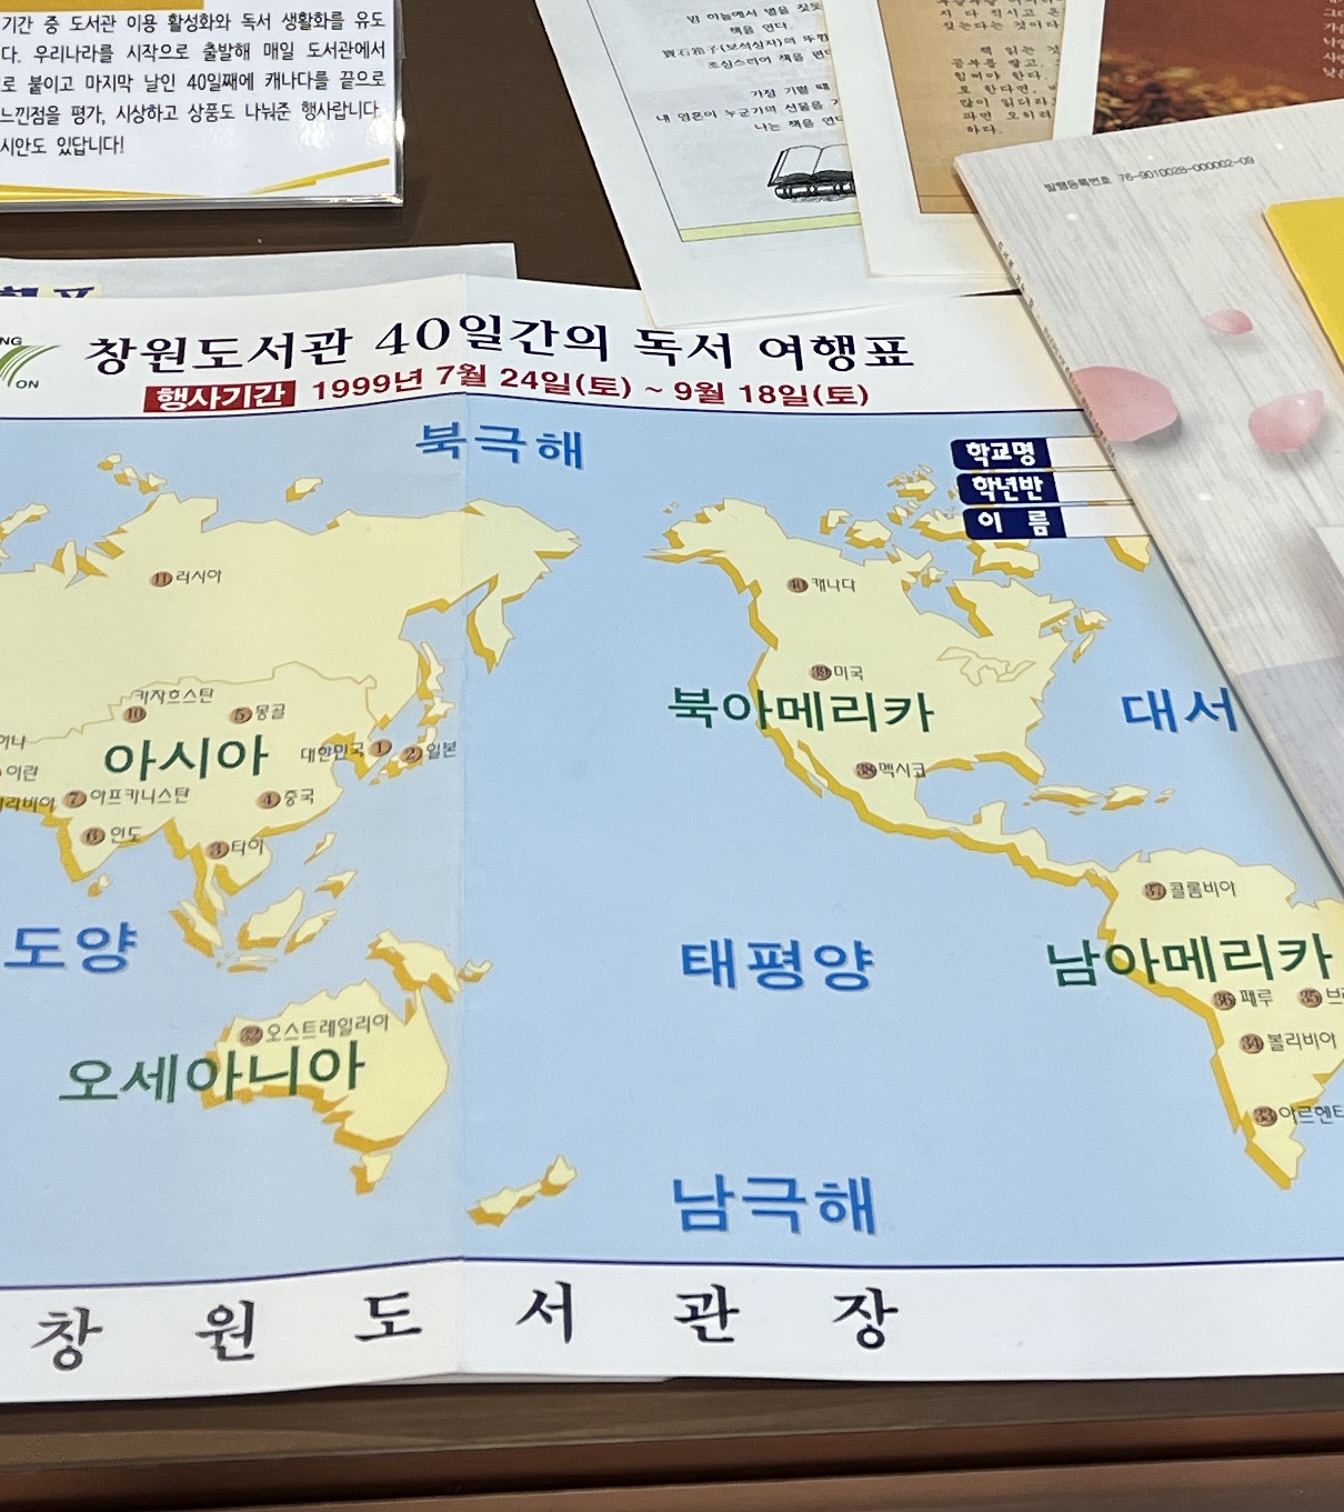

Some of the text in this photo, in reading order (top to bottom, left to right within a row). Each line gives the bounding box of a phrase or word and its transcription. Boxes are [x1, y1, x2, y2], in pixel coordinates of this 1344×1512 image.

[2, 16, 33, 35] 기간
[44, 15, 59, 34] 중
[70, 15, 117, 33] 도서관
[127, 14, 157, 33] 이용
[168, 13, 231, 32] 활성화와
[241, 12, 270, 31] 독서
[282, 12, 344, 31] 생활화를
[355, 11, 385, 29] 유도
[34, 44, 113, 63] 우리나라를
[127, 43, 189, 63] 시작으로
[203, 42, 250, 62] 출발해
[264, 41, 293, 61] 매일
[307, 40, 384, 60] 도서관에서
[28, 75, 74, 94] 붙이고
[86, 74, 134, 93] 마지막
[145, 73, 175, 93] 날인
[187, 72, 253, 92] 40일째에
[265, 71, 329, 90] 캐나다를
[340, 70, 385, 90] 끝으로
[0, 137, 47, 157] 시안도
[57, 136, 123, 156] 있답니다!
[84, 314, 914, 376] 창원도서관 40일간의 독서 여행표
[156, 364, 870, 411] 행사기간 1999년 7월 24일(토) 9월 18일(토)
[414, 422, 585, 470] 북극해
[966, 441, 1035, 467] 학교명
[972, 476, 1044, 503] 학년반
[176, 569, 223, 585] 러시아
[834, 665, 864, 681] 미국
[256, 704, 286, 721] 몽골
[668, 687, 935, 733] 북아메리카
[105, 734, 270, 781] 아시아
[427, 741, 457, 759] 일본
[284, 788, 315, 806] 중국
[1170, 880, 1237, 899] 콜롬비아
[682, 939, 874, 992] 태평양
[1047, 933, 1334, 987] 남아메리카
[1240, 989, 1274, 1007] 페루
[266, 1014, 390, 1043] 오스트레일리아
[1268, 1031, 1337, 1052] 볼리비아
[59, 1041, 367, 1104] 오세아니아
[672, 1175, 879, 1236] 남극해
